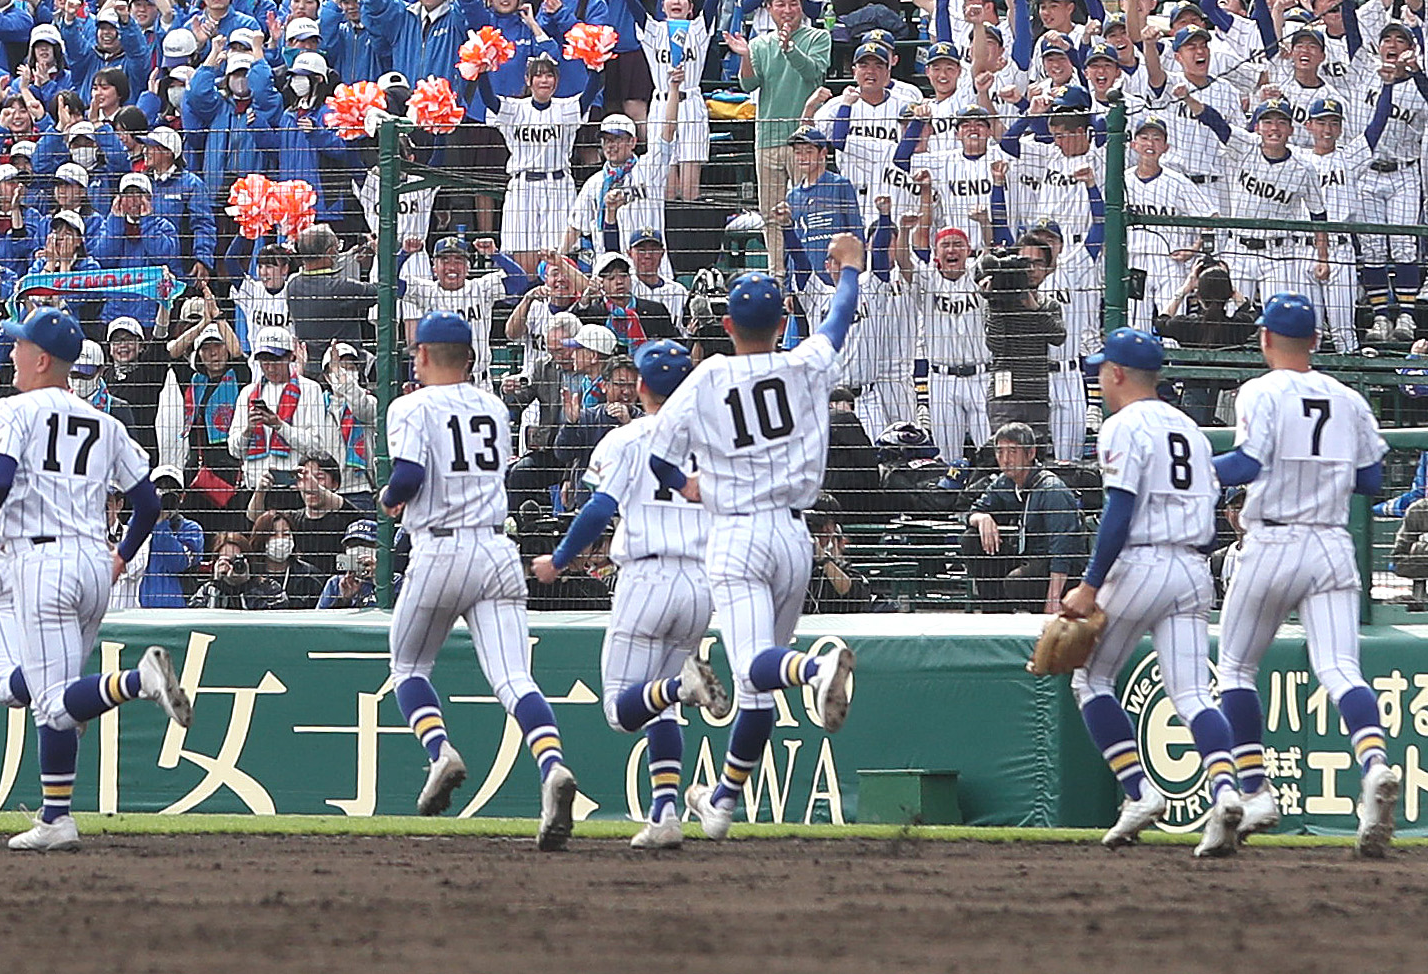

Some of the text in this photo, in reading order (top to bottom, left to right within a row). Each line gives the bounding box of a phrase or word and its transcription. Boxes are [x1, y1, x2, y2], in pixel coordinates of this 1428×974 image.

[1238, 168, 1293, 205] KENDAI
[445, 414, 501, 473] 13
[722, 377, 794, 450] 10
[1301, 398, 1333, 458] 7
[42, 412, 100, 476] 17
[1168, 431, 1194, 492] 8
